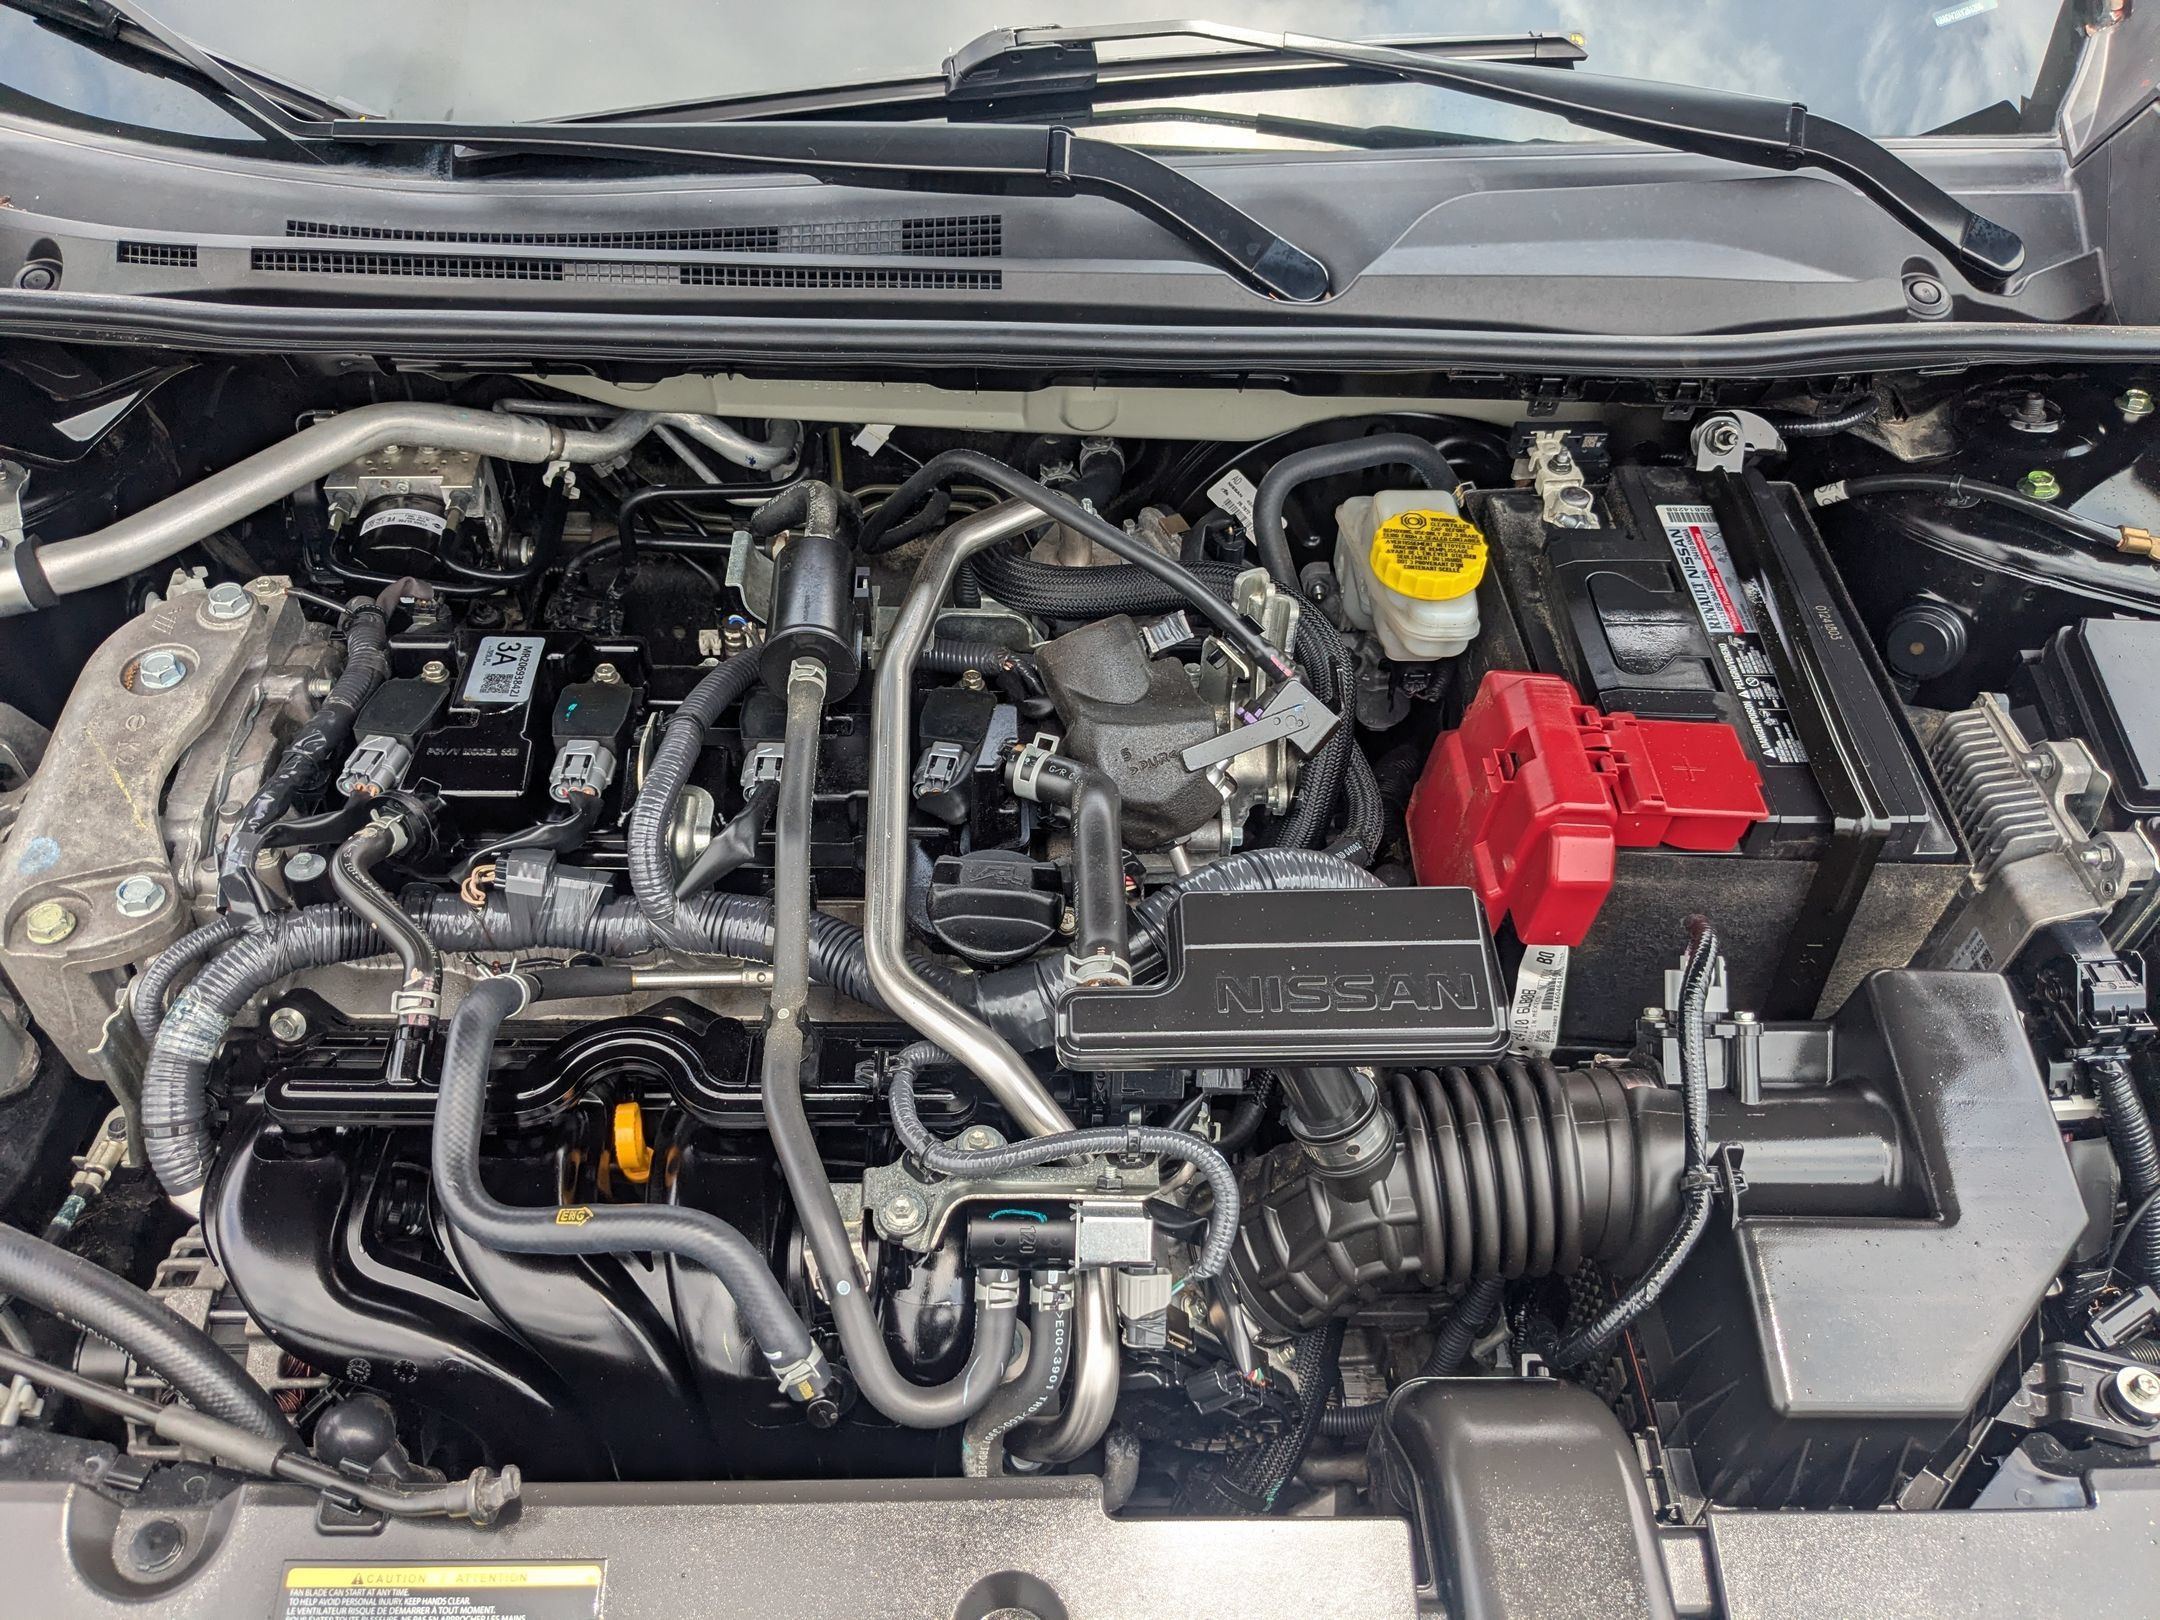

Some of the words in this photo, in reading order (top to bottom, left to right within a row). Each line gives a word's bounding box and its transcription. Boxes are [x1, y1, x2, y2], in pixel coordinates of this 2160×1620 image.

[1667, 528, 1700, 578] NISSAN
[1690, 581, 1723, 629] RENAULT
[491, 642, 522, 667] 3A
[1741, 700, 1770, 748] DANGER/POISON
[462, 747, 498, 756] MODEL
[1215, 973, 1478, 1013] NISSAN
[560, 1210, 585, 1221] ENG
[366, 1573, 426, 1584] CAUTION
[290, 1589, 304, 1597] FAN
[305, 1589, 327, 1597] BLADE
[329, 1589, 345, 1597] CAN
[346, 1589, 366, 1597] START
[366, 1589, 375, 1597] AT
[376, 1589, 391, 1597] ANY
[290, 1597, 299, 1605] TO
[300, 1597, 317, 1605] HELP
[318, 1597, 341, 1605] AVOID
[341, 1597, 377, 1605] PERSONAL
[404, 1597, 421, 1605] KEEP
[422, 1597, 447, 1605] HANDS
[286, 1606, 297, 1615] LE
[297, 1606, 347, 1615] VENTILATEUR
[348, 1606, 376, 1615] RISQUE
[377, 1606, 388, 1615] DE
[389, 1606, 430, 1615] DÉMARRER
[438, 1606, 459, 1615] TOUT
[460, 1606, 496, 1615] MOMENT.
